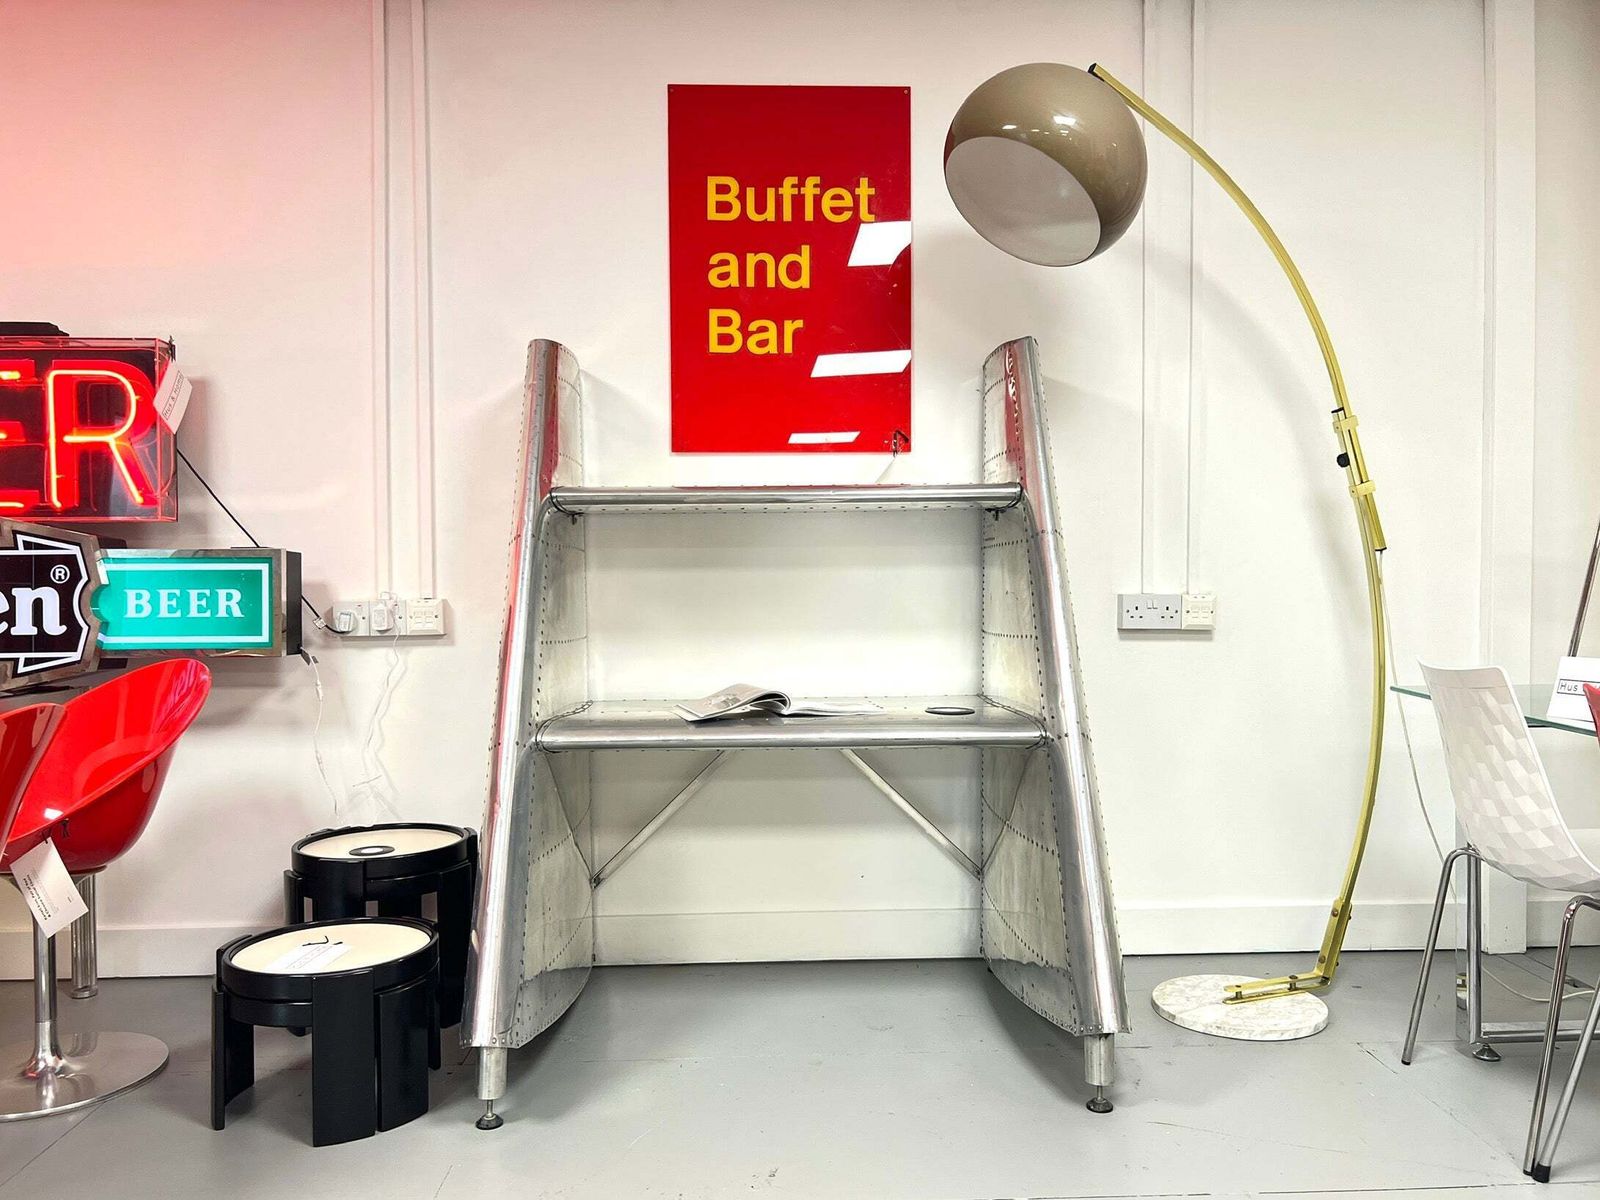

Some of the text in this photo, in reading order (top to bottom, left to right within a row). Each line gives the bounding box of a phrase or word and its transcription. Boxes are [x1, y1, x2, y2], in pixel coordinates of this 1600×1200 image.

[707, 175, 876, 223] Buffet
[707, 244, 811, 290] and
[708, 308, 804, 355] Bar
[0, 586, 68, 636] n
[123, 588, 245, 618] BEER
[1559, 682, 1578, 692] Hus
